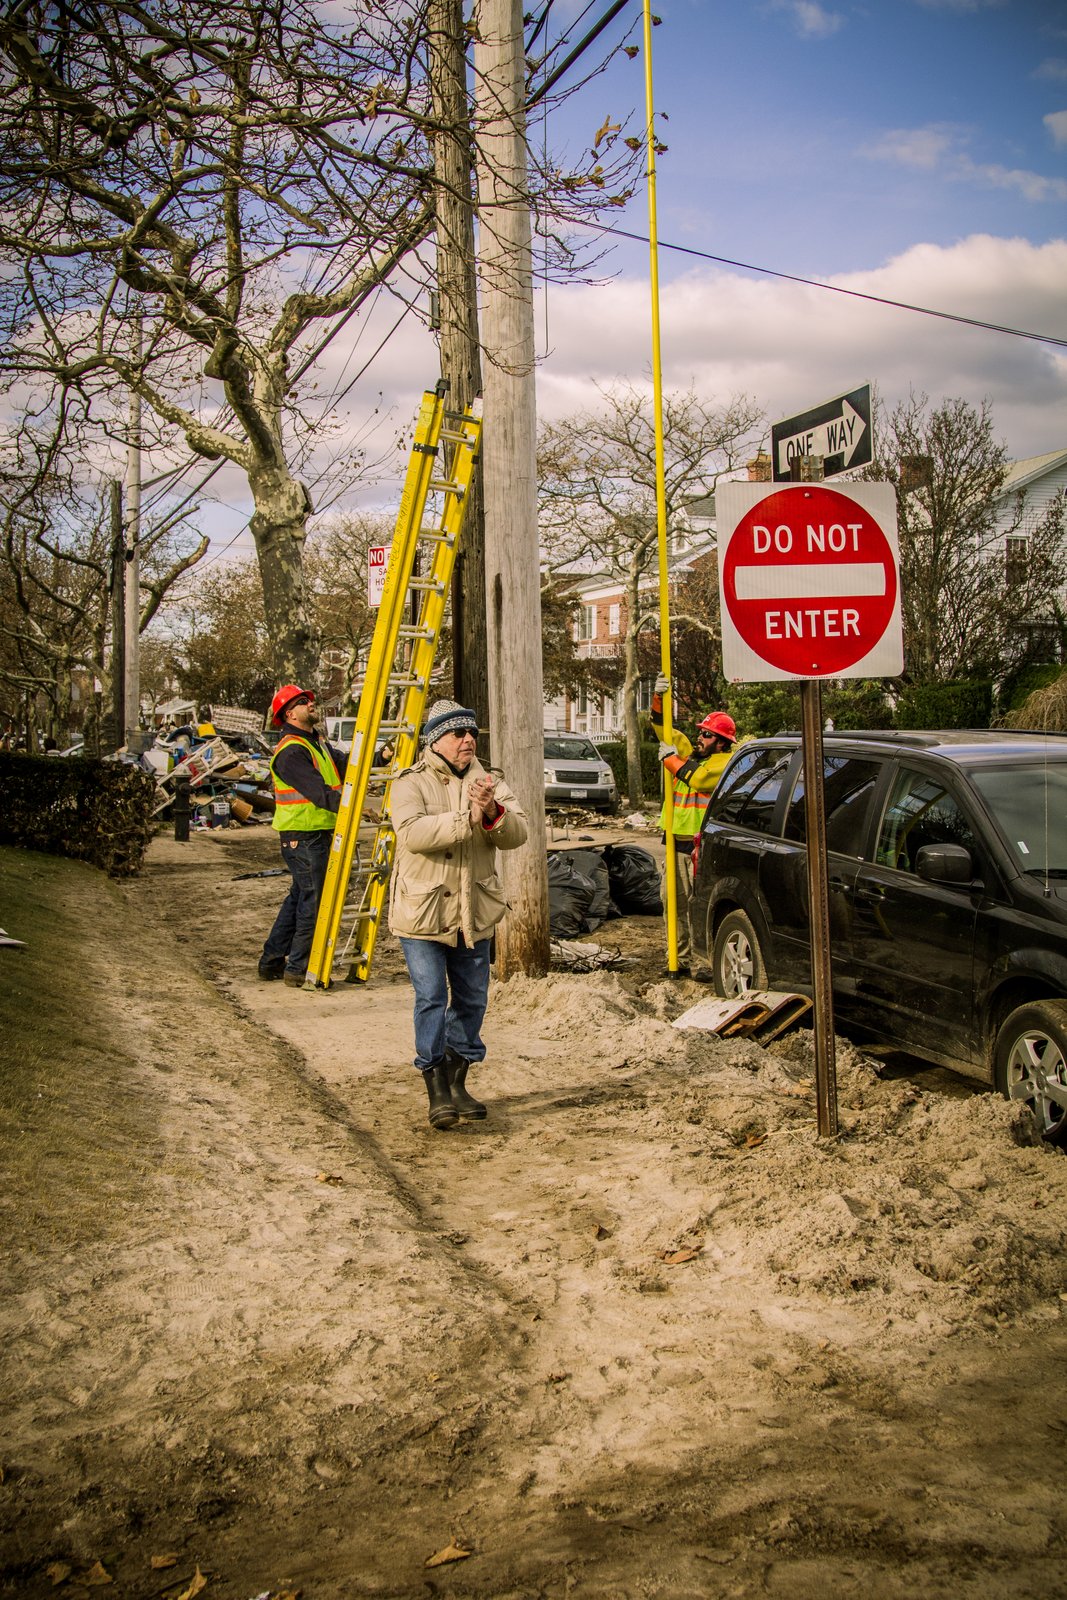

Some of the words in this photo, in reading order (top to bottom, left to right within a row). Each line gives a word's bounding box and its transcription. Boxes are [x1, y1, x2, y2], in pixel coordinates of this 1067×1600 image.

[786, 433, 813, 467] ONE
[827, 415, 856, 453] WAY
[753, 525, 793, 553] DO
[806, 524, 863, 552] NOT
[370, 550, 384, 564] NO
[765, 608, 861, 639] ENTER
